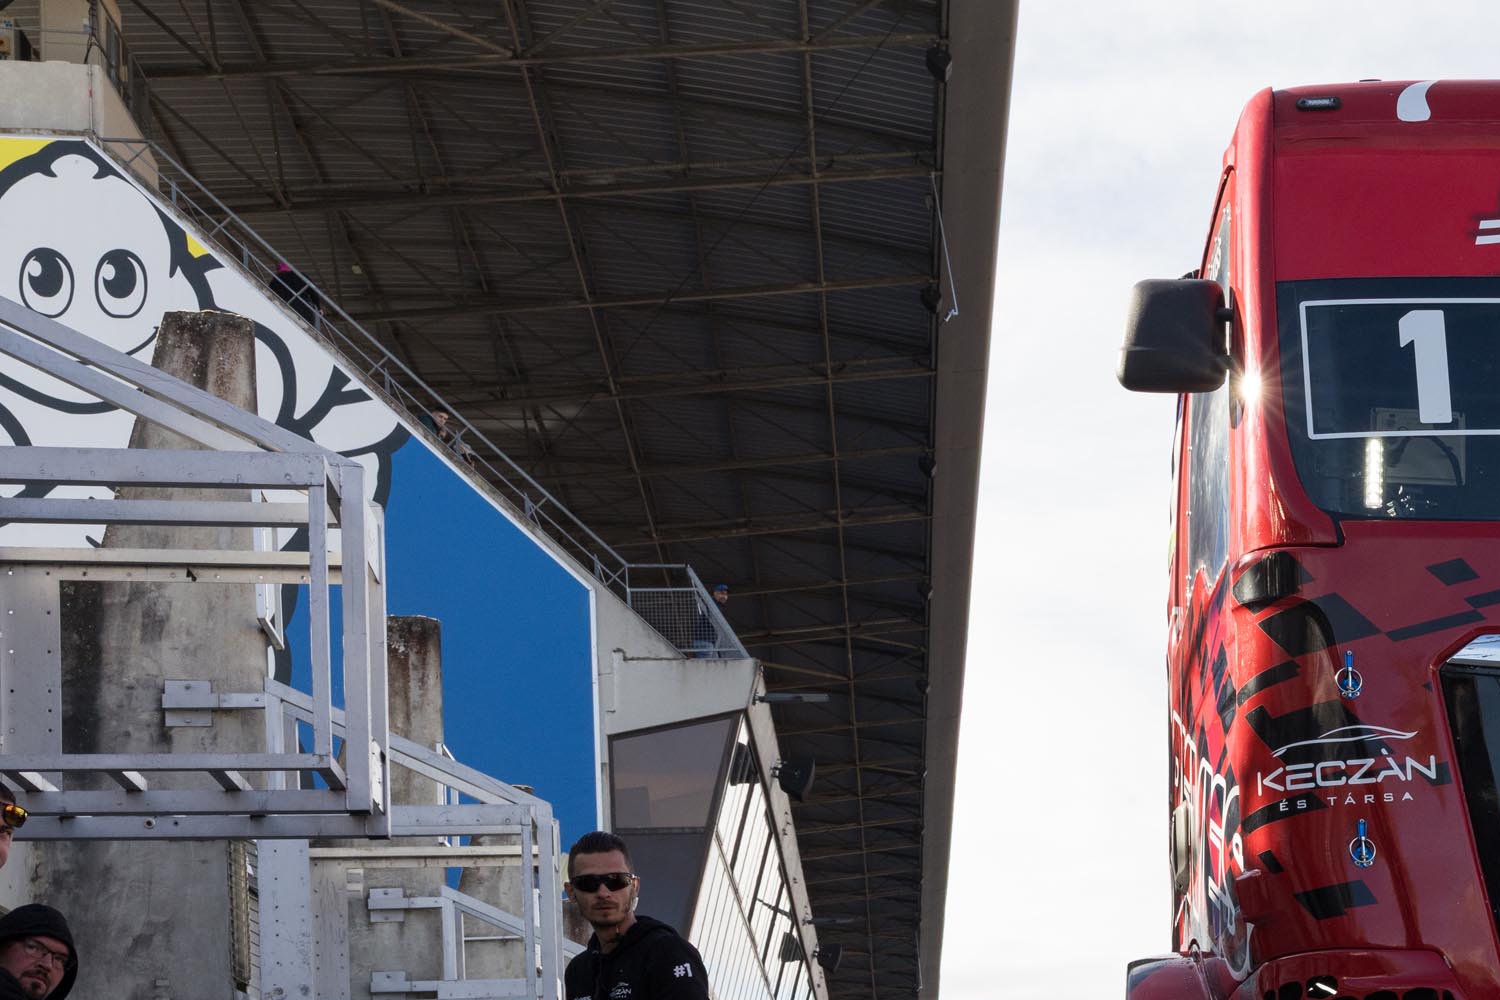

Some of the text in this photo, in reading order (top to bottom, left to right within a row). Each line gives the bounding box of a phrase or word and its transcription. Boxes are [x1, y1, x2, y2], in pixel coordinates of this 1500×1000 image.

[1398, 309, 1453, 424] 1
[1279, 791, 1414, 812] ÉS TÁRSA
[673, 963, 693, 978] #1
